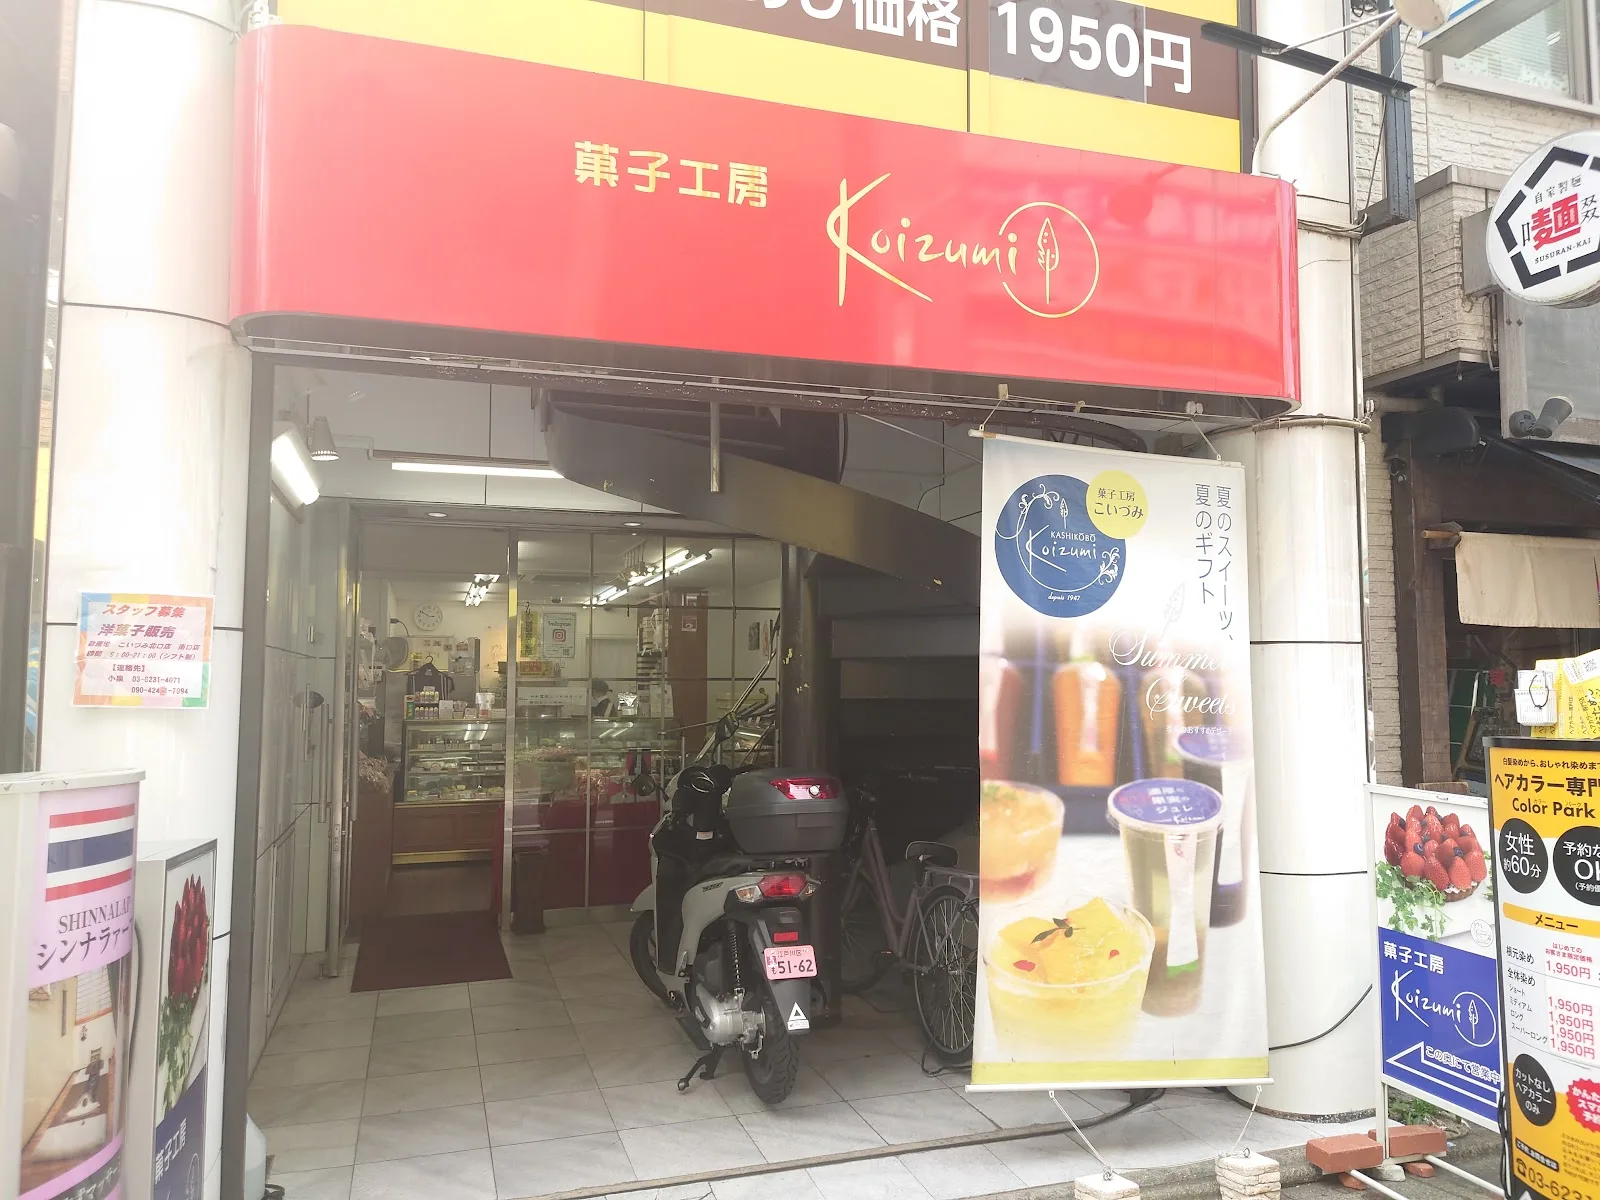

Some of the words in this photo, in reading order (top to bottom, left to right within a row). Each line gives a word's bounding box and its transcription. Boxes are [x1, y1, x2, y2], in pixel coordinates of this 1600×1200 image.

[762, 0, 962, 48] 価格
[997, 2, 1192, 95] 1950円
[573, 140, 768, 208] 菓子工房
[826, 172, 1018, 307] Koizumi
[1534, 237, 1592, 264] SUSURAN-KAI
[1097, 487, 1135, 502] 菓子工房
[1094, 501, 1144, 520] こいづみ
[1025, 524, 1097, 575] Koizumi
[1195, 483, 1214, 604] 夏のギフト
[102, 603, 187, 618] スタッフ募集
[97, 623, 177, 639] 洋菓子販売
[1502, 757, 1600, 771] 白髪染めから、おしゃれ染めま
[1512, 797, 1548, 814] Color
[1552, 801, 1596, 819] Park
[1504, 830, 1536, 856] 女性
[1503, 854, 1542, 879] 約60分
[1534, 914, 1579, 931] メニュー
[36, 918, 134, 972] シンナラァー
[777, 959, 814, 974] 51-62
[1383, 941, 1445, 975] 菓子工房
[1507, 967, 1536, 987] 全体染め
[1545, 960, 1591, 980] 1,950円
[1391, 969, 1462, 1028] Koizumi
[1548, 995, 1593, 1017] 1,950円
[1548, 1011, 1594, 1032] 1,950円
[1549, 1024, 1594, 1046] 1,950円
[1550, 1037, 1595, 1060] 1,950円
[1425, 1044, 1500, 1086] この奥にて営業中
[1515, 1067, 1551, 1093] カットなし
[1515, 1082, 1552, 1104] ヘアカラー
[1525, 1101, 1541, 1115] のみ
